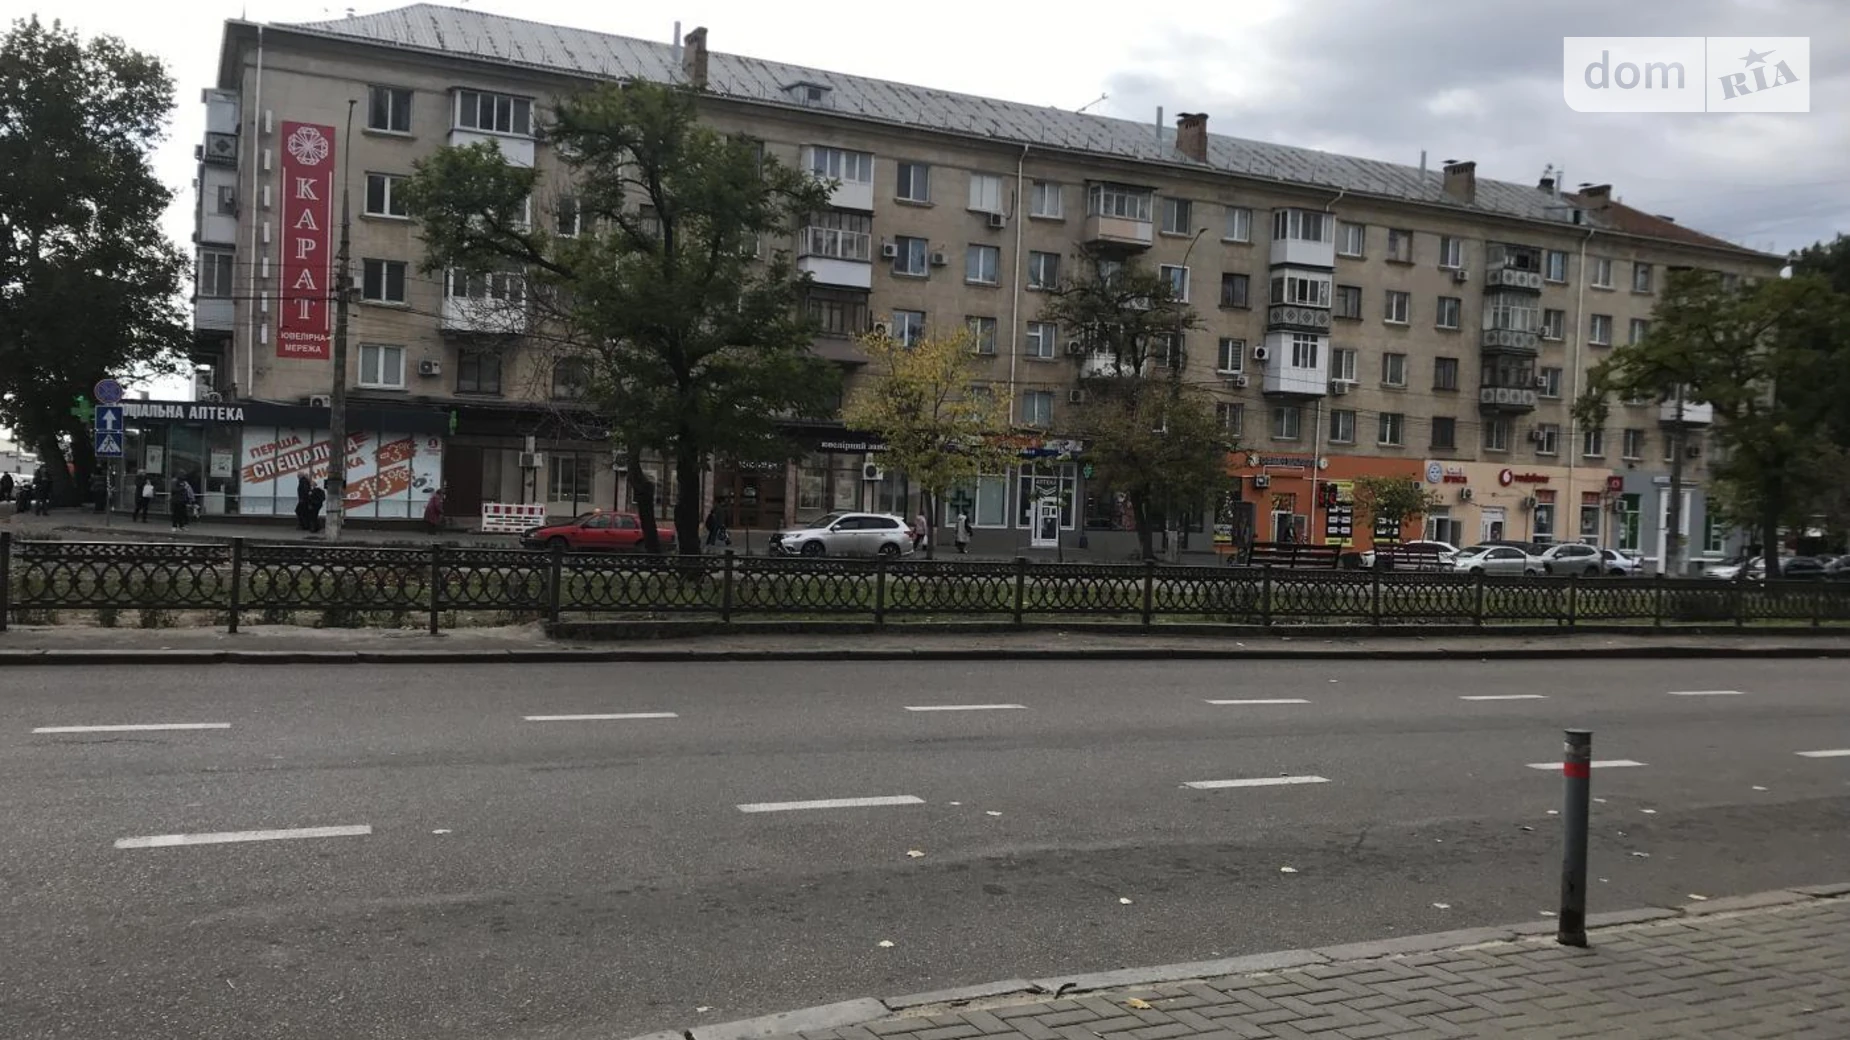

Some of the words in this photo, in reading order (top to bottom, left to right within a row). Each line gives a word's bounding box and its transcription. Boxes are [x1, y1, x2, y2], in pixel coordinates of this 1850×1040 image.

[293, 176, 319, 320] КАРАТ
[280, 331, 326, 342] ЮВЕЛІРНА
[284, 344, 322, 354] МЕРЕЖА
[118, 402, 184, 419] ОЦІАЛЬНА
[188, 405, 244, 421] АПТЕКА
[250, 435, 302, 459] ПЕРША
